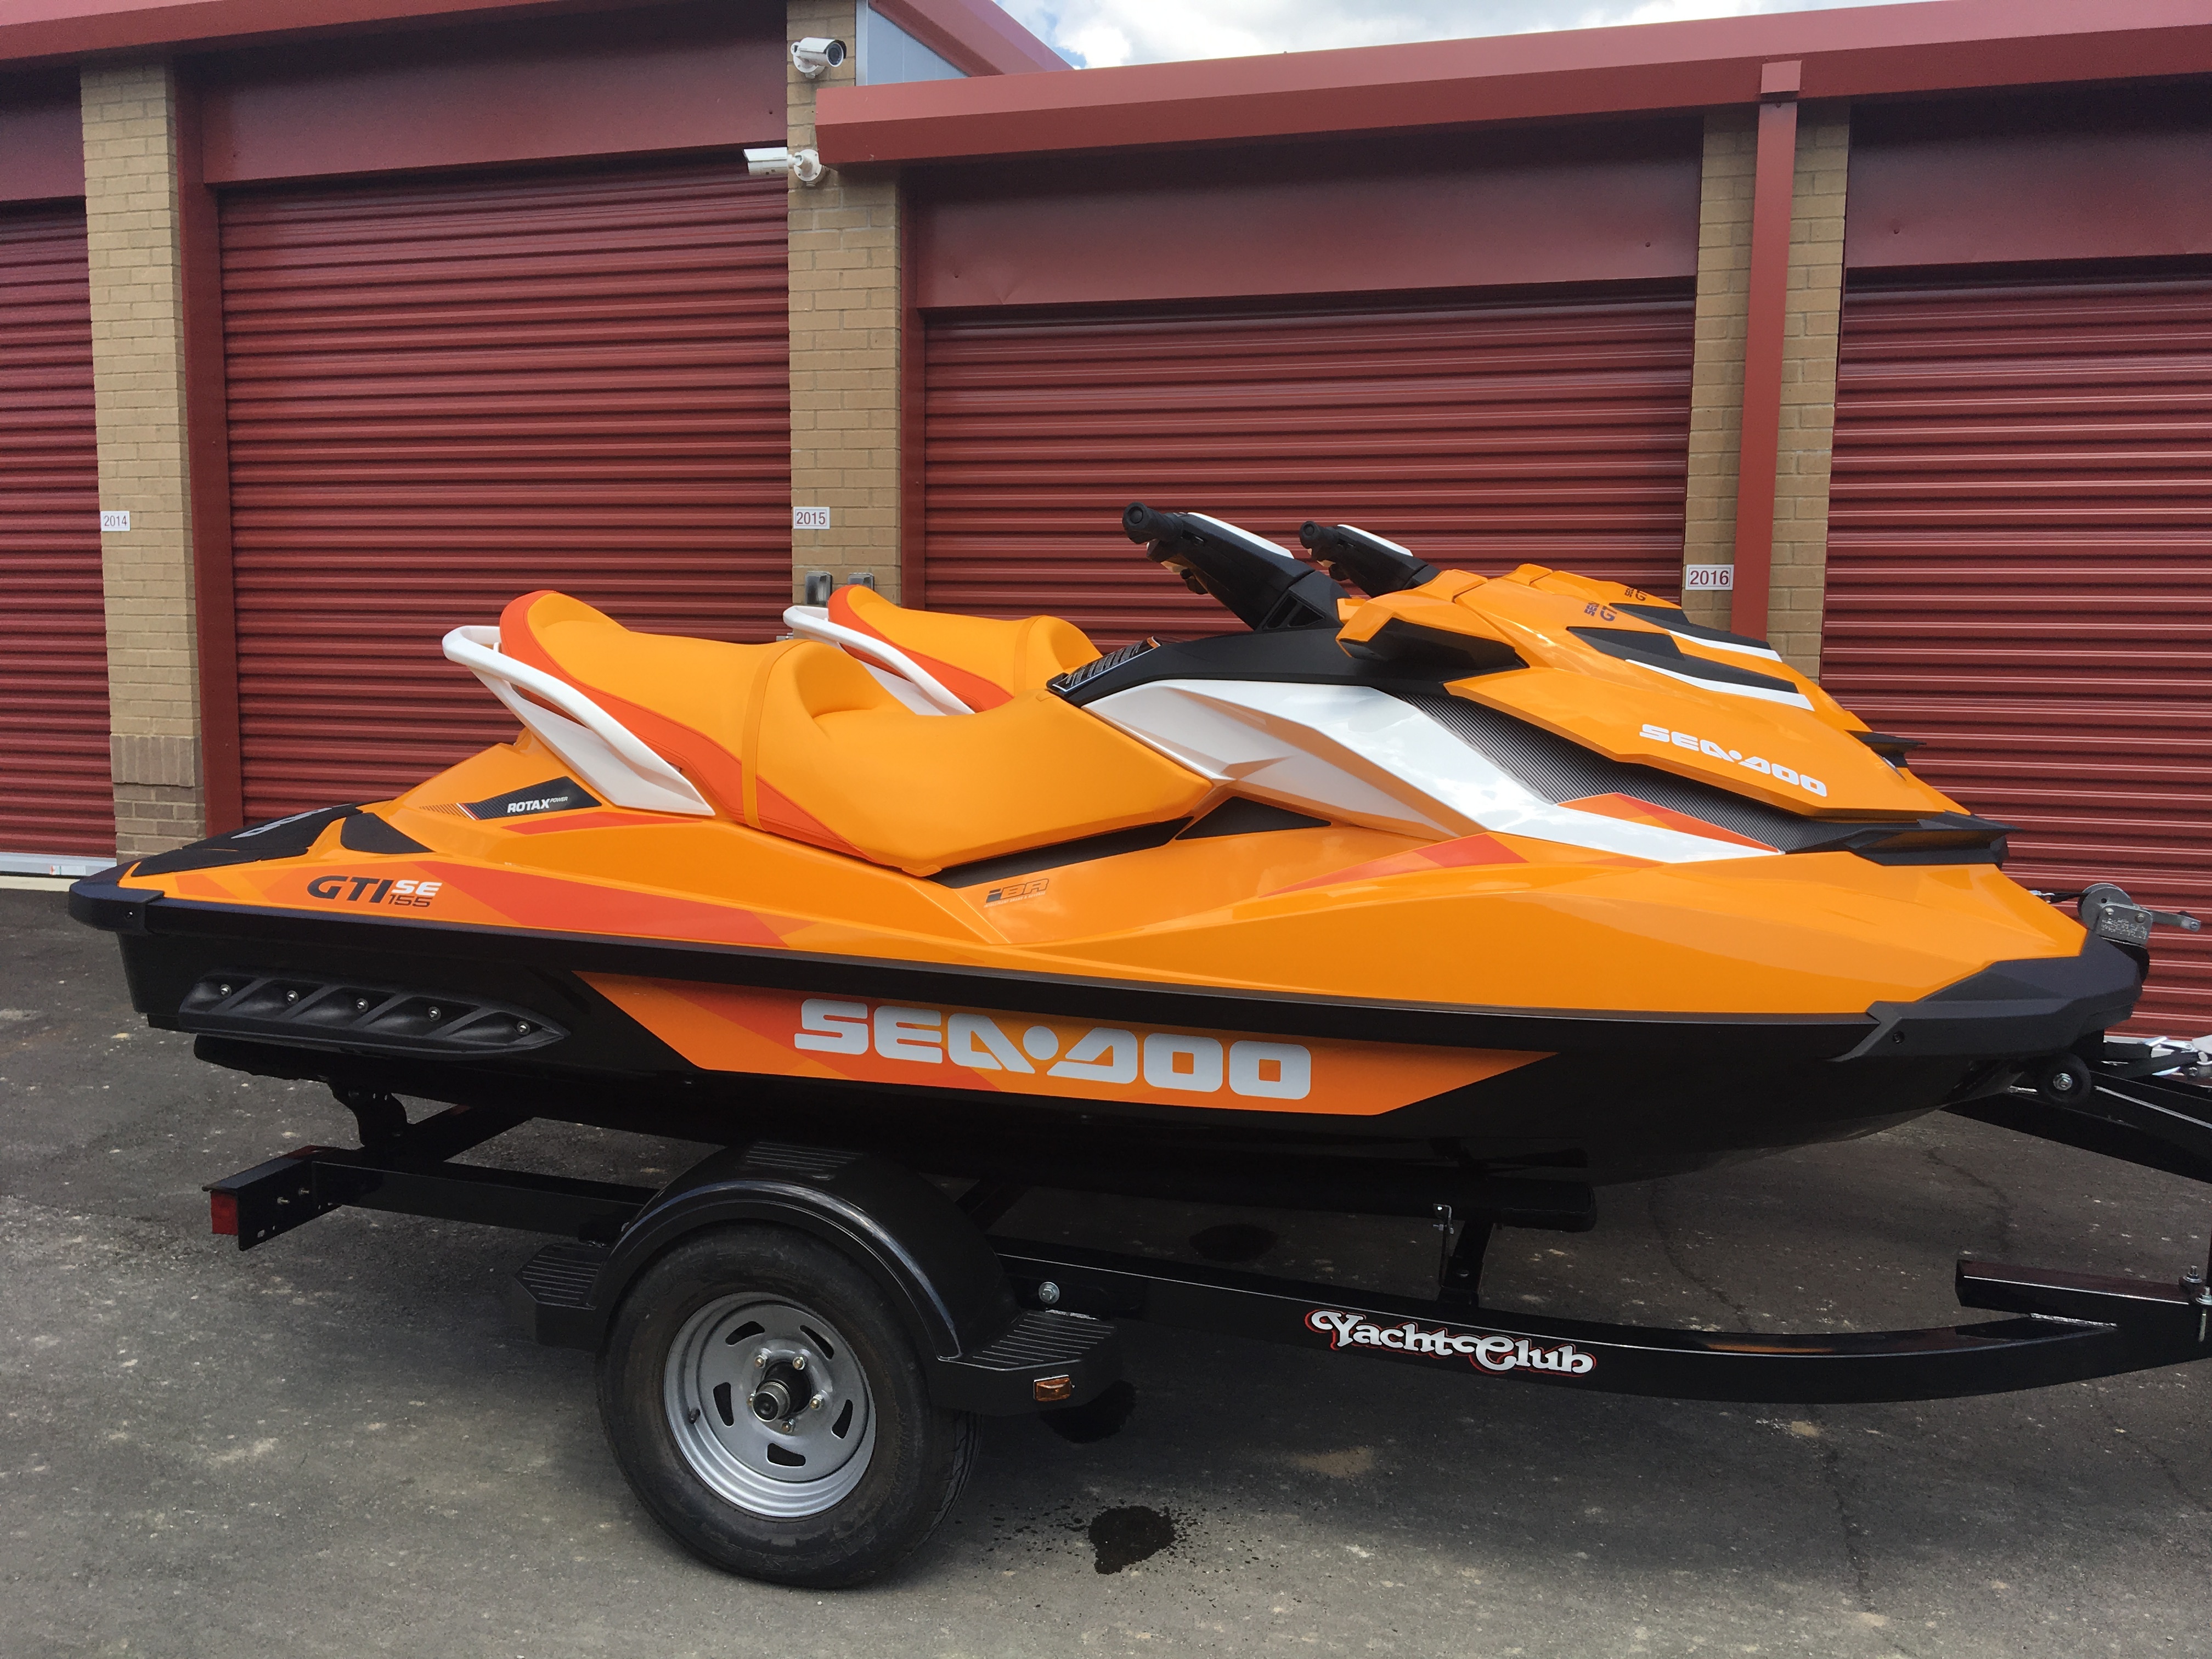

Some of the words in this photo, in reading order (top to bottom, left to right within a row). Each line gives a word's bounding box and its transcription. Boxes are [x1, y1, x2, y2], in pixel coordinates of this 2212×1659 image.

[104, 515, 127, 527] 2014
[796, 511, 826, 525] 2015
[1690, 570, 1729, 585] 2016
[507, 799, 550, 813] ROTAX
[307, 875, 394, 904] GTI
[391, 880, 443, 896] SE
[388, 894, 433, 907] 155
[1309, 1310, 1453, 1356] Yacht
[1453, 1335, 1593, 1372] Club
